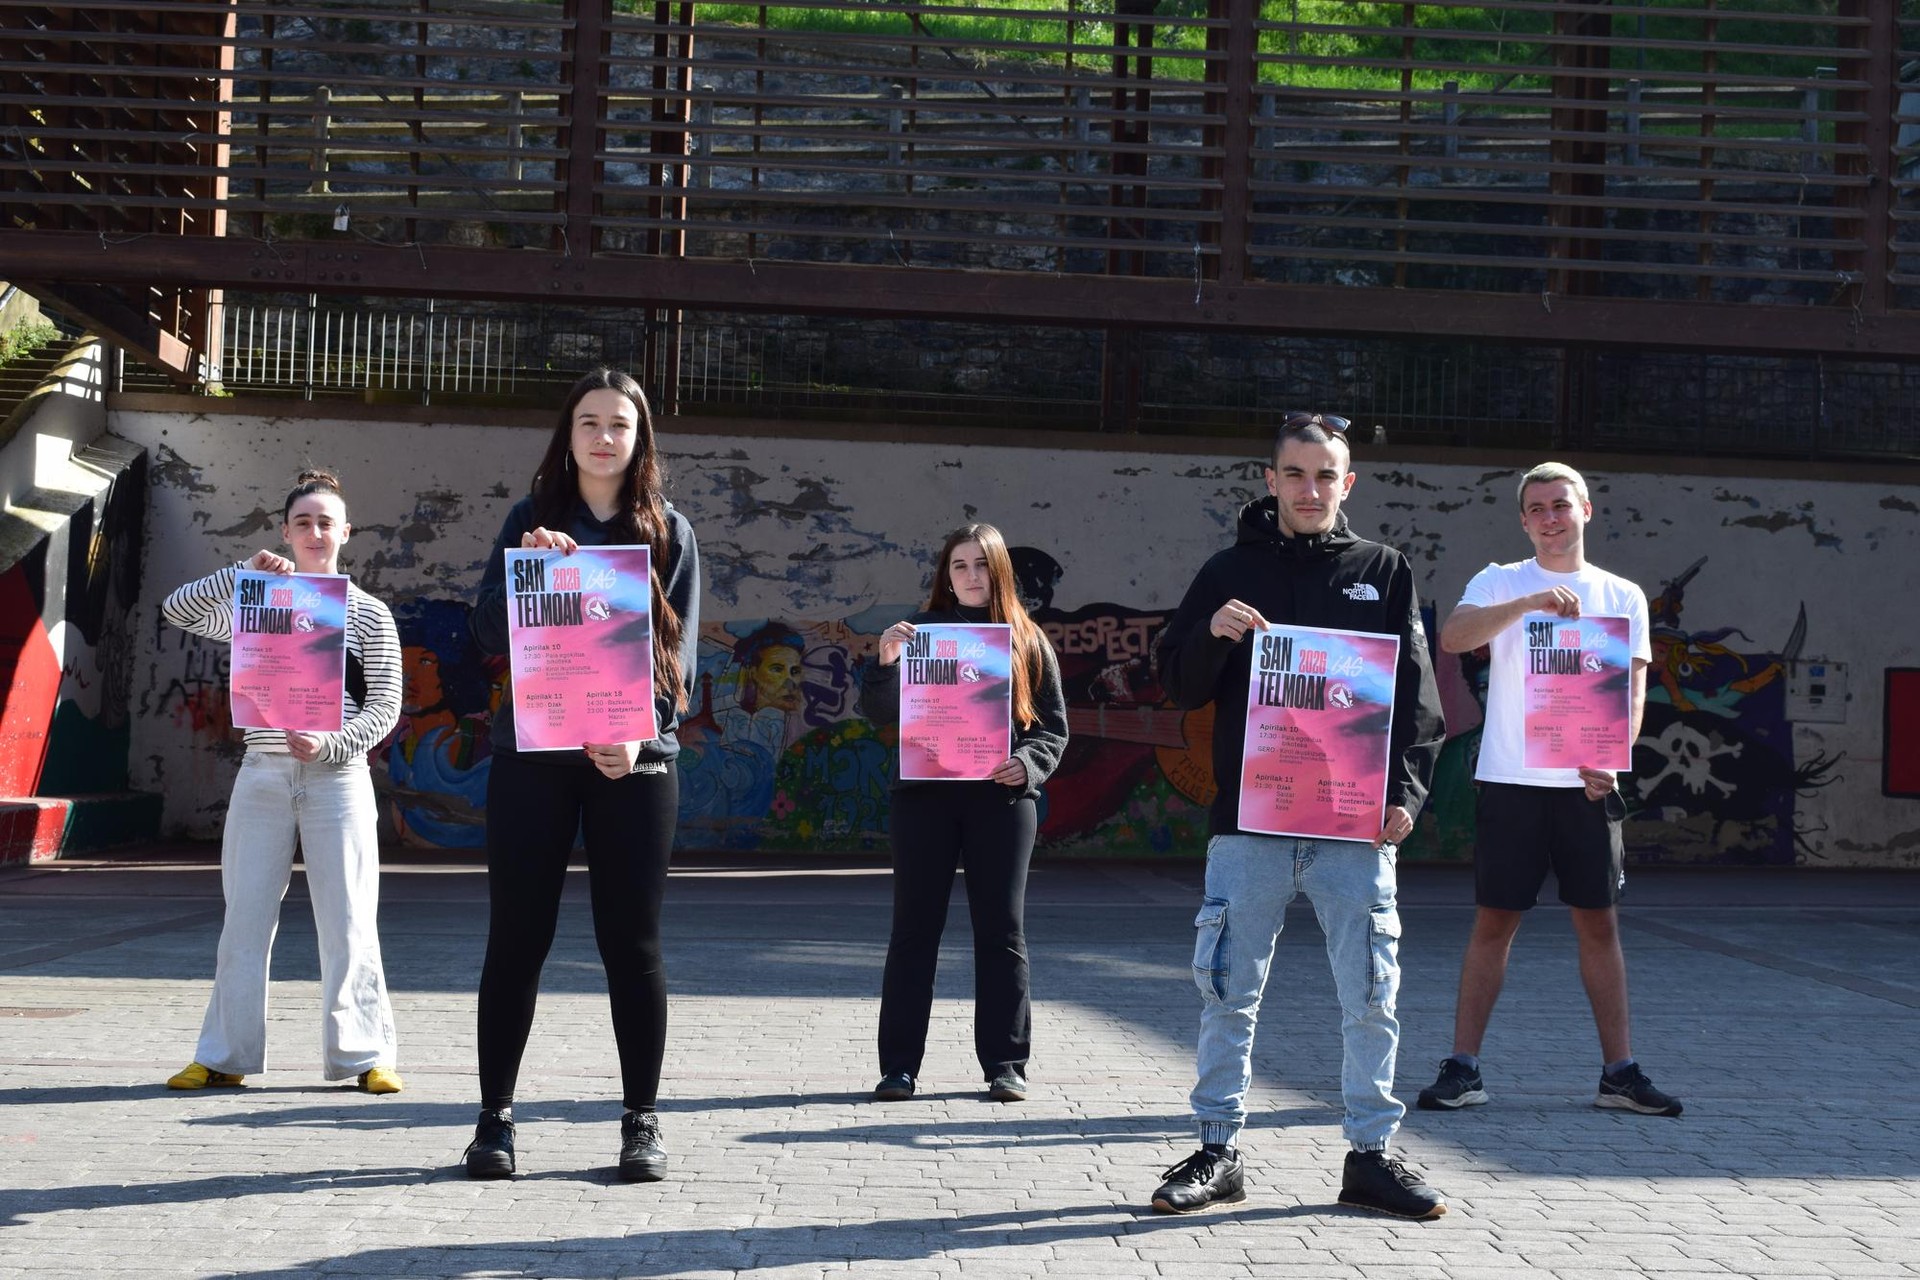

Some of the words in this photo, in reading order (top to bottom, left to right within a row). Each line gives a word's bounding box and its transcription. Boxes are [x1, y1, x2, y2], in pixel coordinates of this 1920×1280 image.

[513, 558, 545, 593] SAN
[552, 567, 581, 591] 2026
[240, 579, 266, 606] SAN
[271, 589, 293, 607] 2026
[240, 606, 293, 635] TELMOAK
[515, 592, 584, 628] TELMOAK
[907, 632, 930, 658] SAN
[1042, 616, 1164, 662] RESPECT
[1529, 621, 1553, 648] SAN
[1559, 630, 1580, 648] 2026
[523, 644, 550, 652] Apirilak
[936, 640, 958, 658] 2026
[1259, 635, 1293, 672] SAN
[907, 659, 958, 685] TELMOAK
[1298, 649, 1328, 675] 2026
[1529, 648, 1582, 675] TELMOAK
[1258, 670, 1327, 711] TELMOAK
[1259, 723, 1287, 732] Apirilak
[1257, 745, 1276, 753] GERO
[1255, 773, 1283, 782] Apirilak
[1318, 779, 1345, 787] Apirilak
[1339, 798, 1375, 806] Kontzertuak
